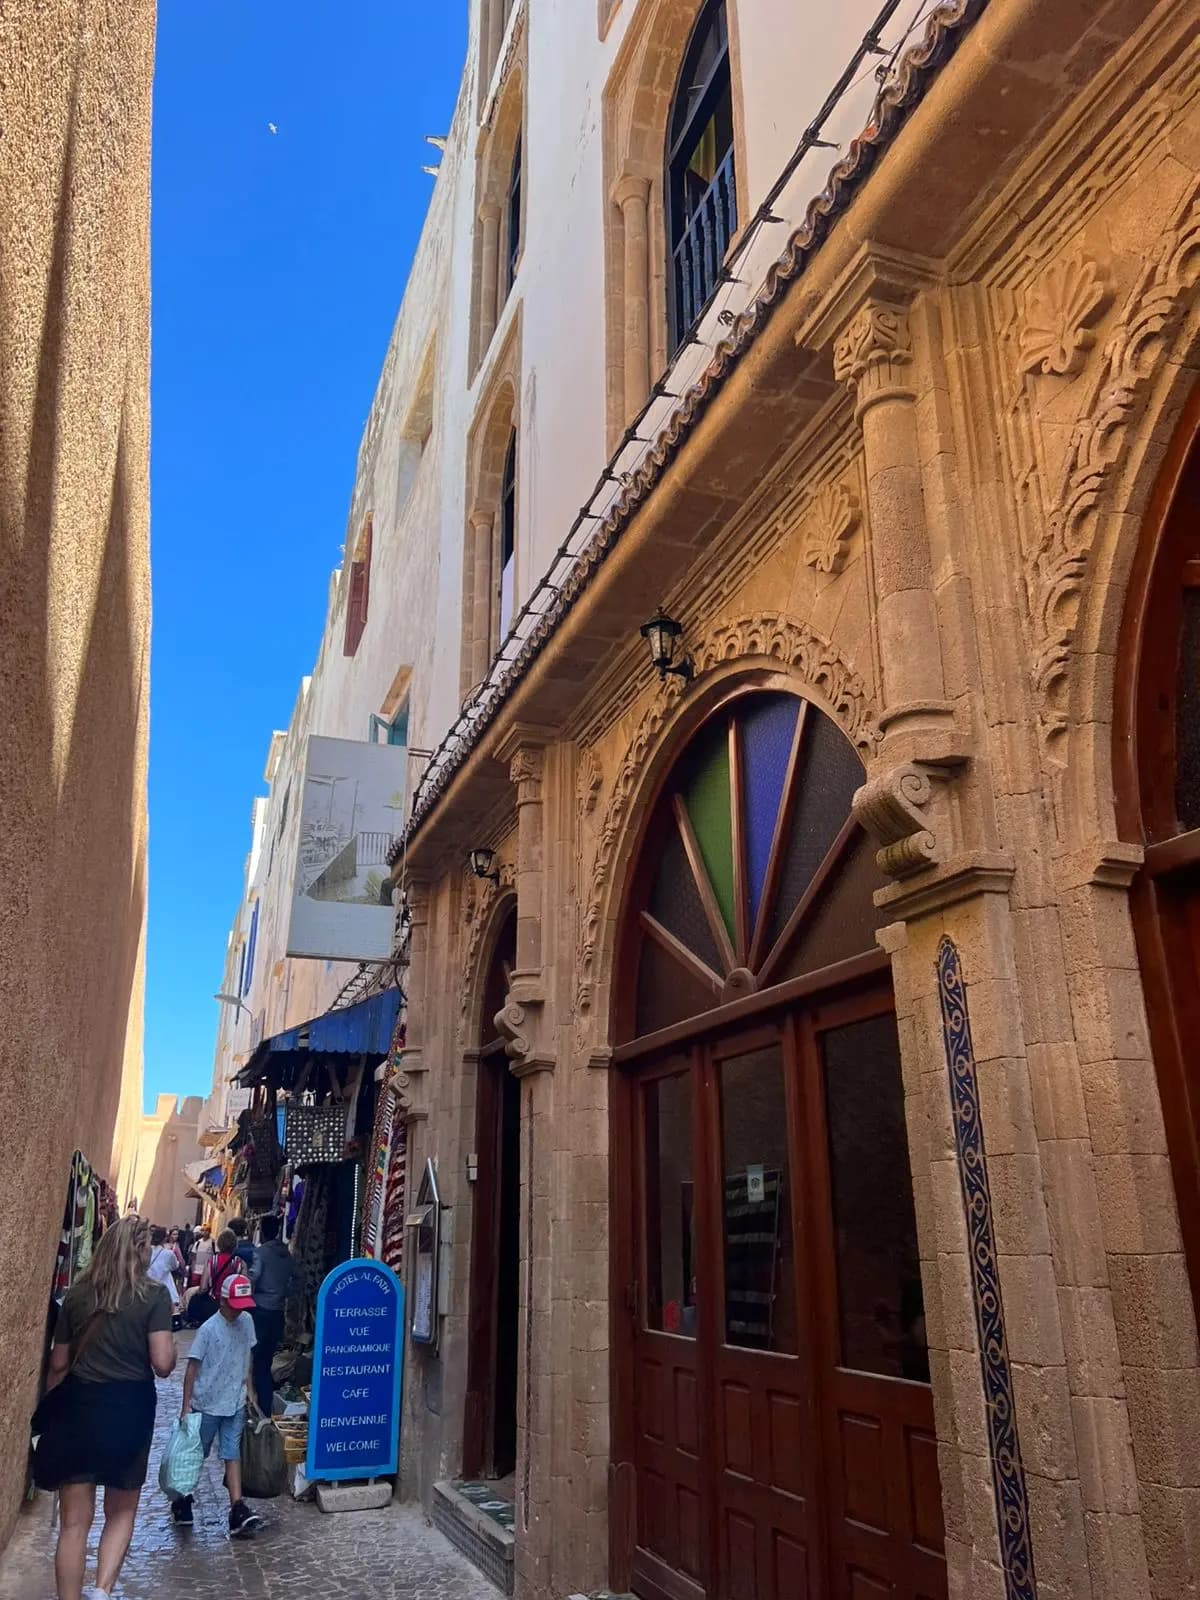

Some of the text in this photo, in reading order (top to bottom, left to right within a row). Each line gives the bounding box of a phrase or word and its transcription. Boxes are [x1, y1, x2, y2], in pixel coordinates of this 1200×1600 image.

[333, 1273, 359, 1296] HOTEL
[372, 1274, 391, 1295] FATH
[334, 1306, 389, 1318] TERRASSE
[349, 1326, 370, 1336] VUE
[324, 1343, 391, 1355] PANORAMIQUE
[322, 1363, 391, 1377] RESTAURANT
[342, 1387, 370, 1399] CAFE
[320, 1413, 388, 1428] BIENVENNUE
[326, 1439, 380, 1453] WELCOME
